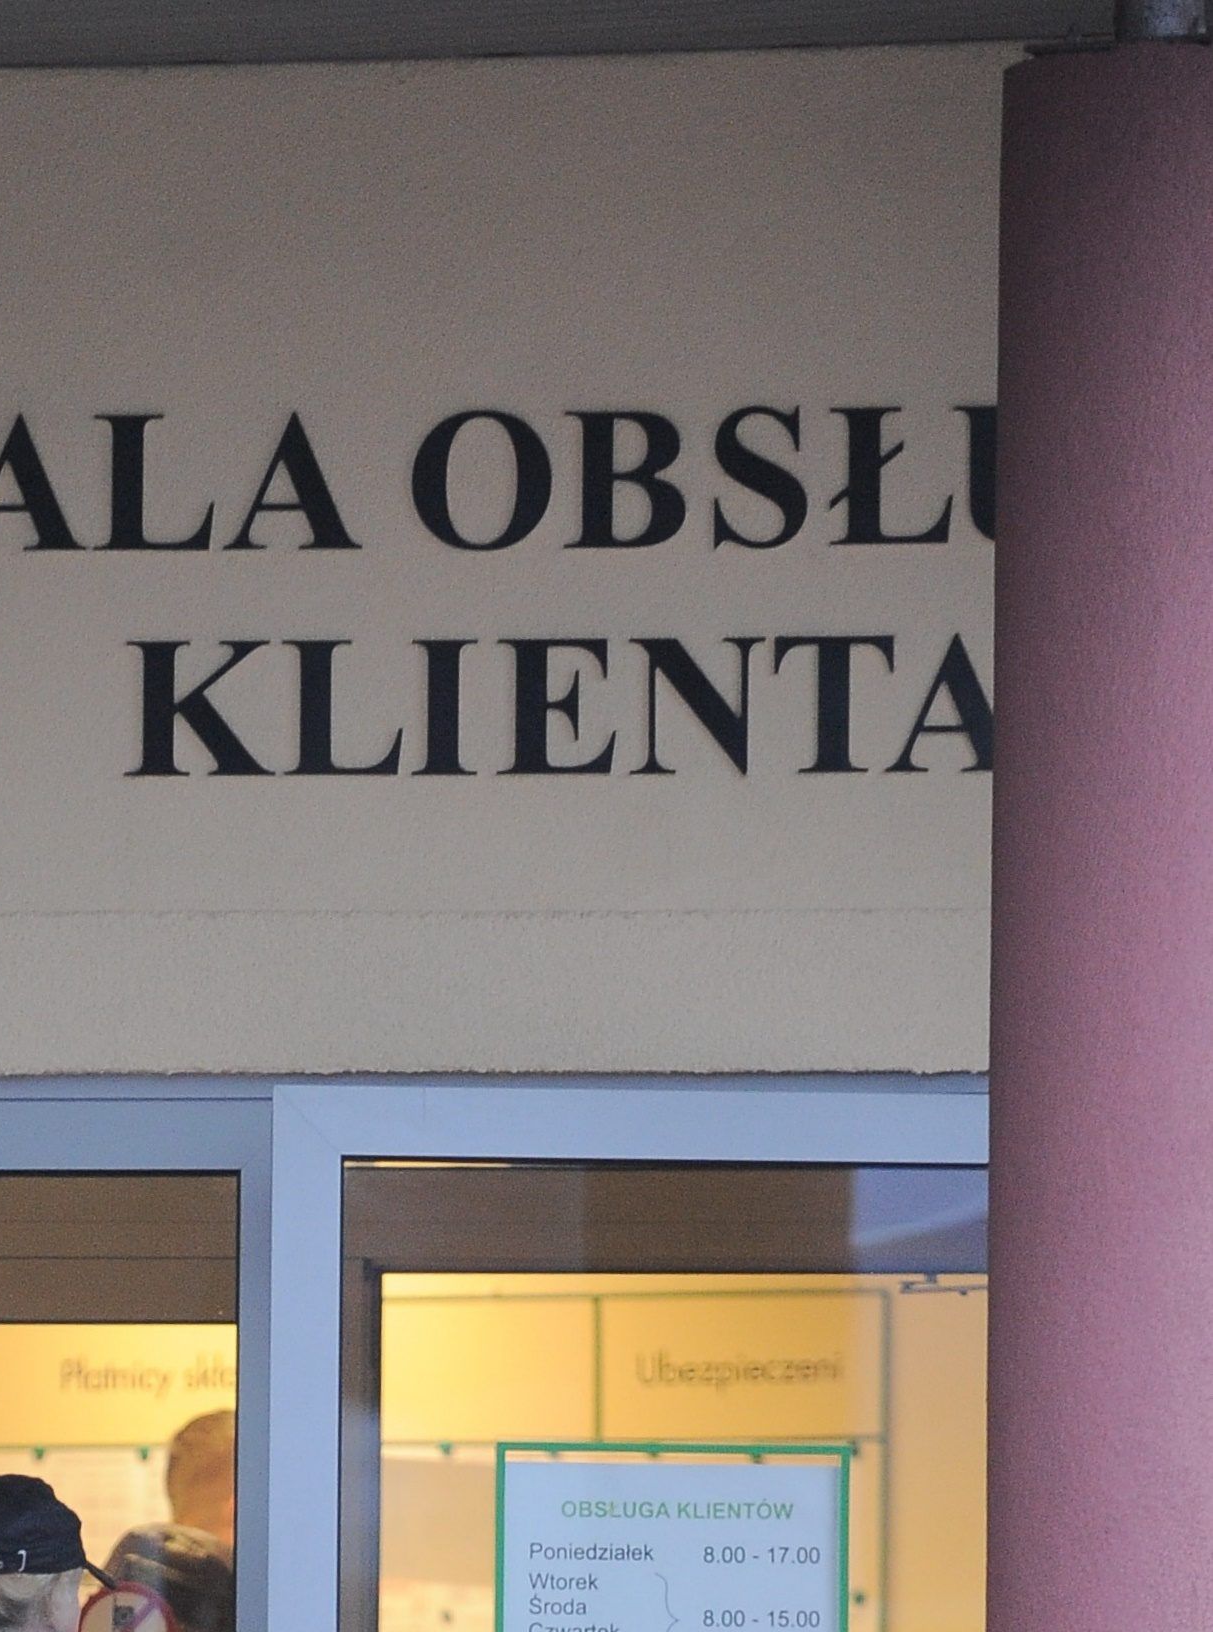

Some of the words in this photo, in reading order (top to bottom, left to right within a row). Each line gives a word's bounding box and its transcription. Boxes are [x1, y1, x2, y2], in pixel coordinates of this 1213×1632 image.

[123, 632, 994, 776] KLIENTA
[561, 1500, 670, 1519] OBSŁUGA
[677, 1499, 794, 1520] KLIENTÓW
[528, 1542, 654, 1562] Poniedziałek
[703, 1546, 746, 1564] 8.00
[768, 1546, 821, 1564] 17.00
[528, 1572, 599, 1590] Wtorek
[528, 1595, 587, 1616] Środa
[703, 1610, 746, 1628] 8.00
[768, 1610, 821, 1628] 15.00
